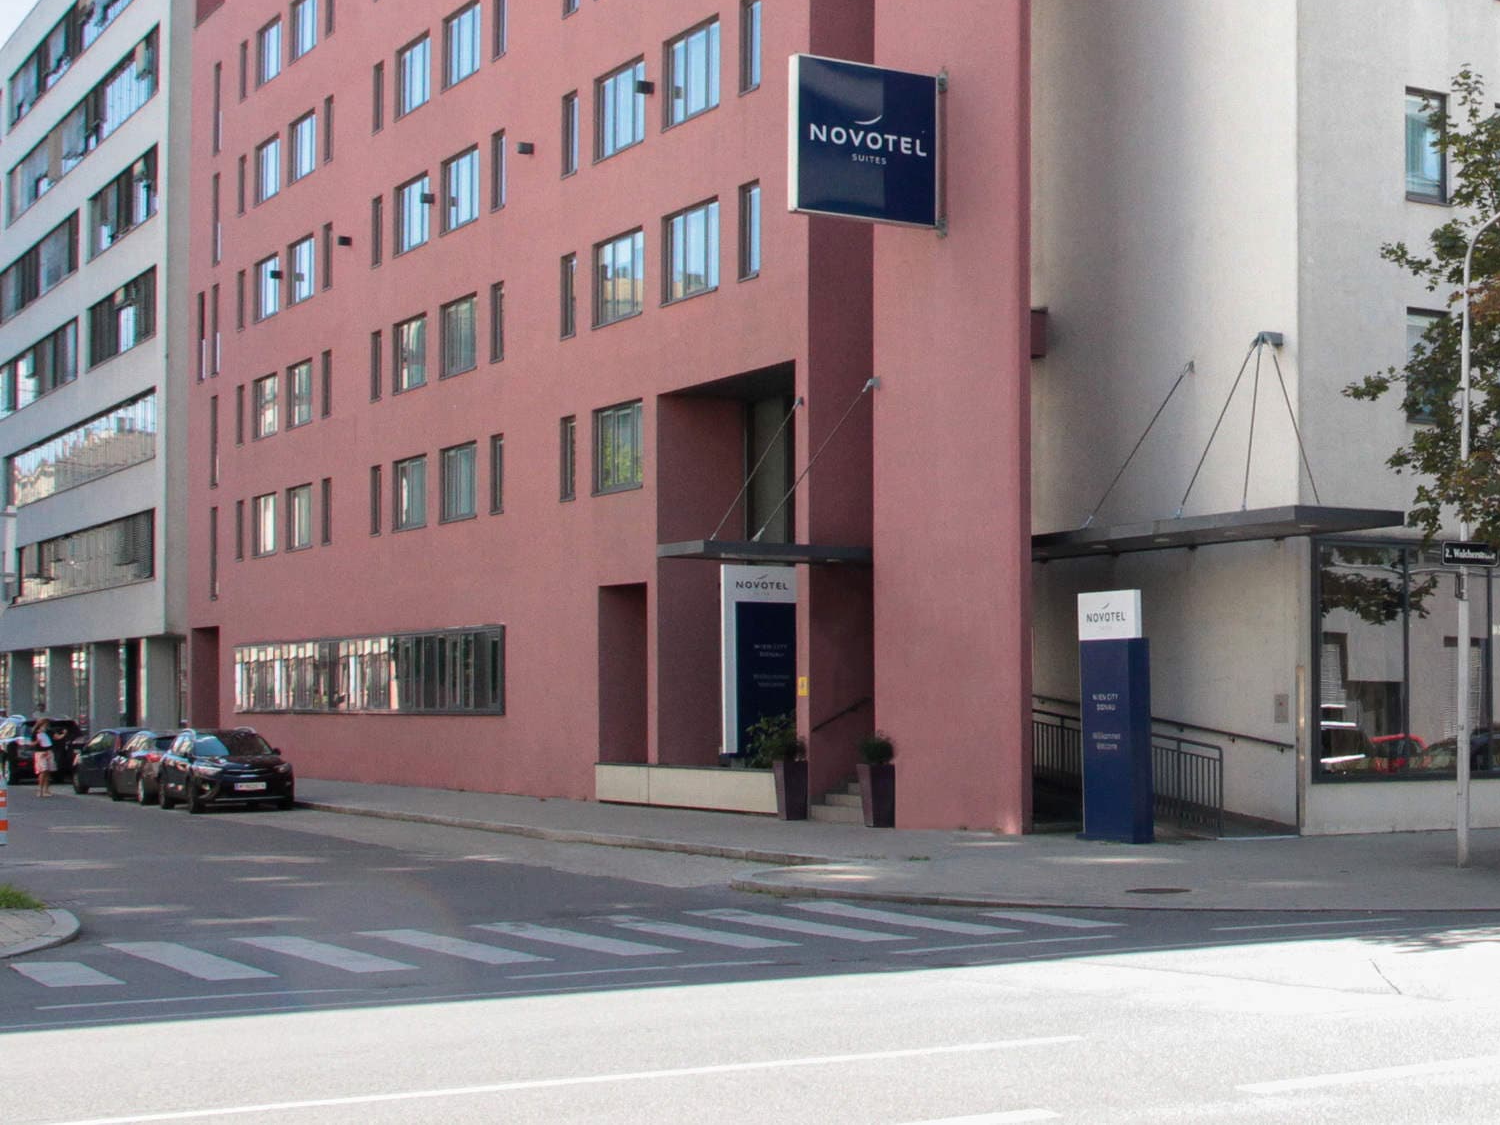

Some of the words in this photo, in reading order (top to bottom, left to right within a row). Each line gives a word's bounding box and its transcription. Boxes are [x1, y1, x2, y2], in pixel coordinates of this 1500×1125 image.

[809, 122, 927, 157] NOVOTEL
[852, 153, 887, 165] SUITES
[736, 580, 789, 591] NOVOTEL
[1086, 611, 1126, 623] NOVOTEL
